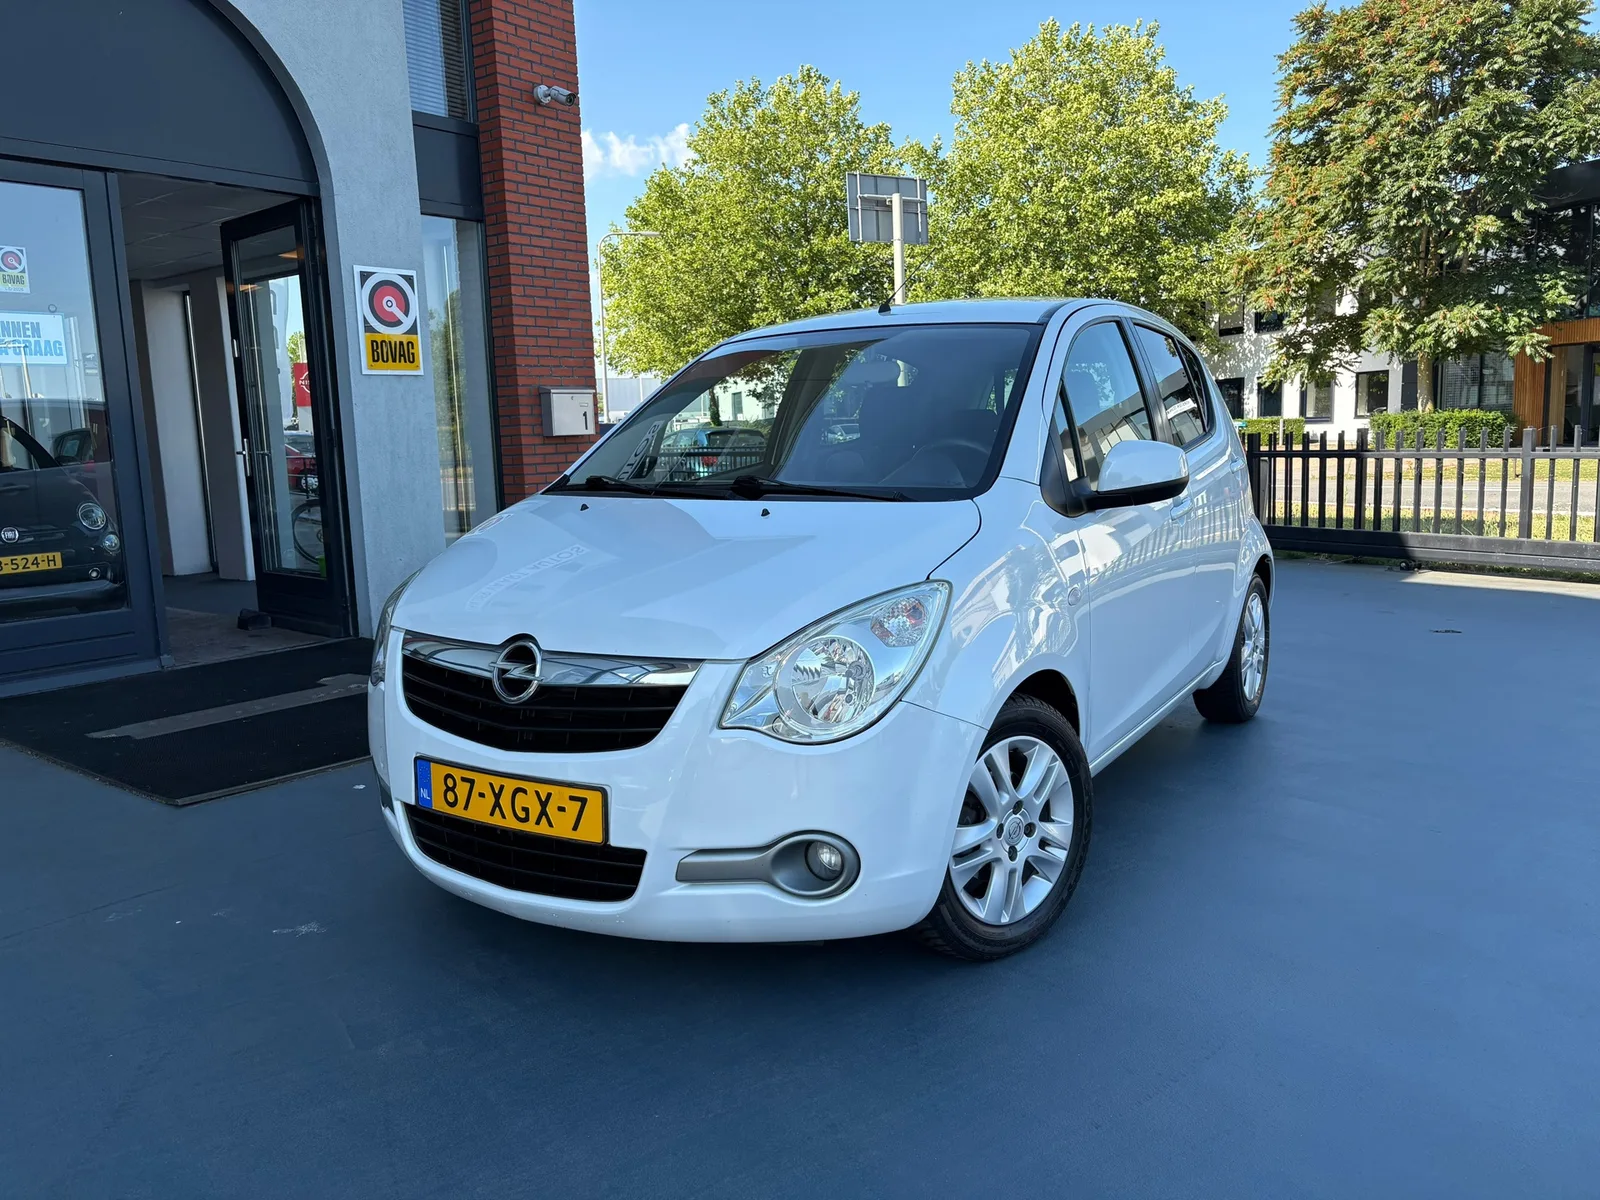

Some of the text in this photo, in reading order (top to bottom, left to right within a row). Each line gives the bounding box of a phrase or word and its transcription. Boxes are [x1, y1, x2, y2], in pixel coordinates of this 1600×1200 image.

[0, 320, 42, 339] NNEN
[370, 339, 416, 364] BOVAG
[582, 411, 589, 431] 1
[420, 788, 431, 800] NL
[443, 772, 589, 832] 87-XGX-7
